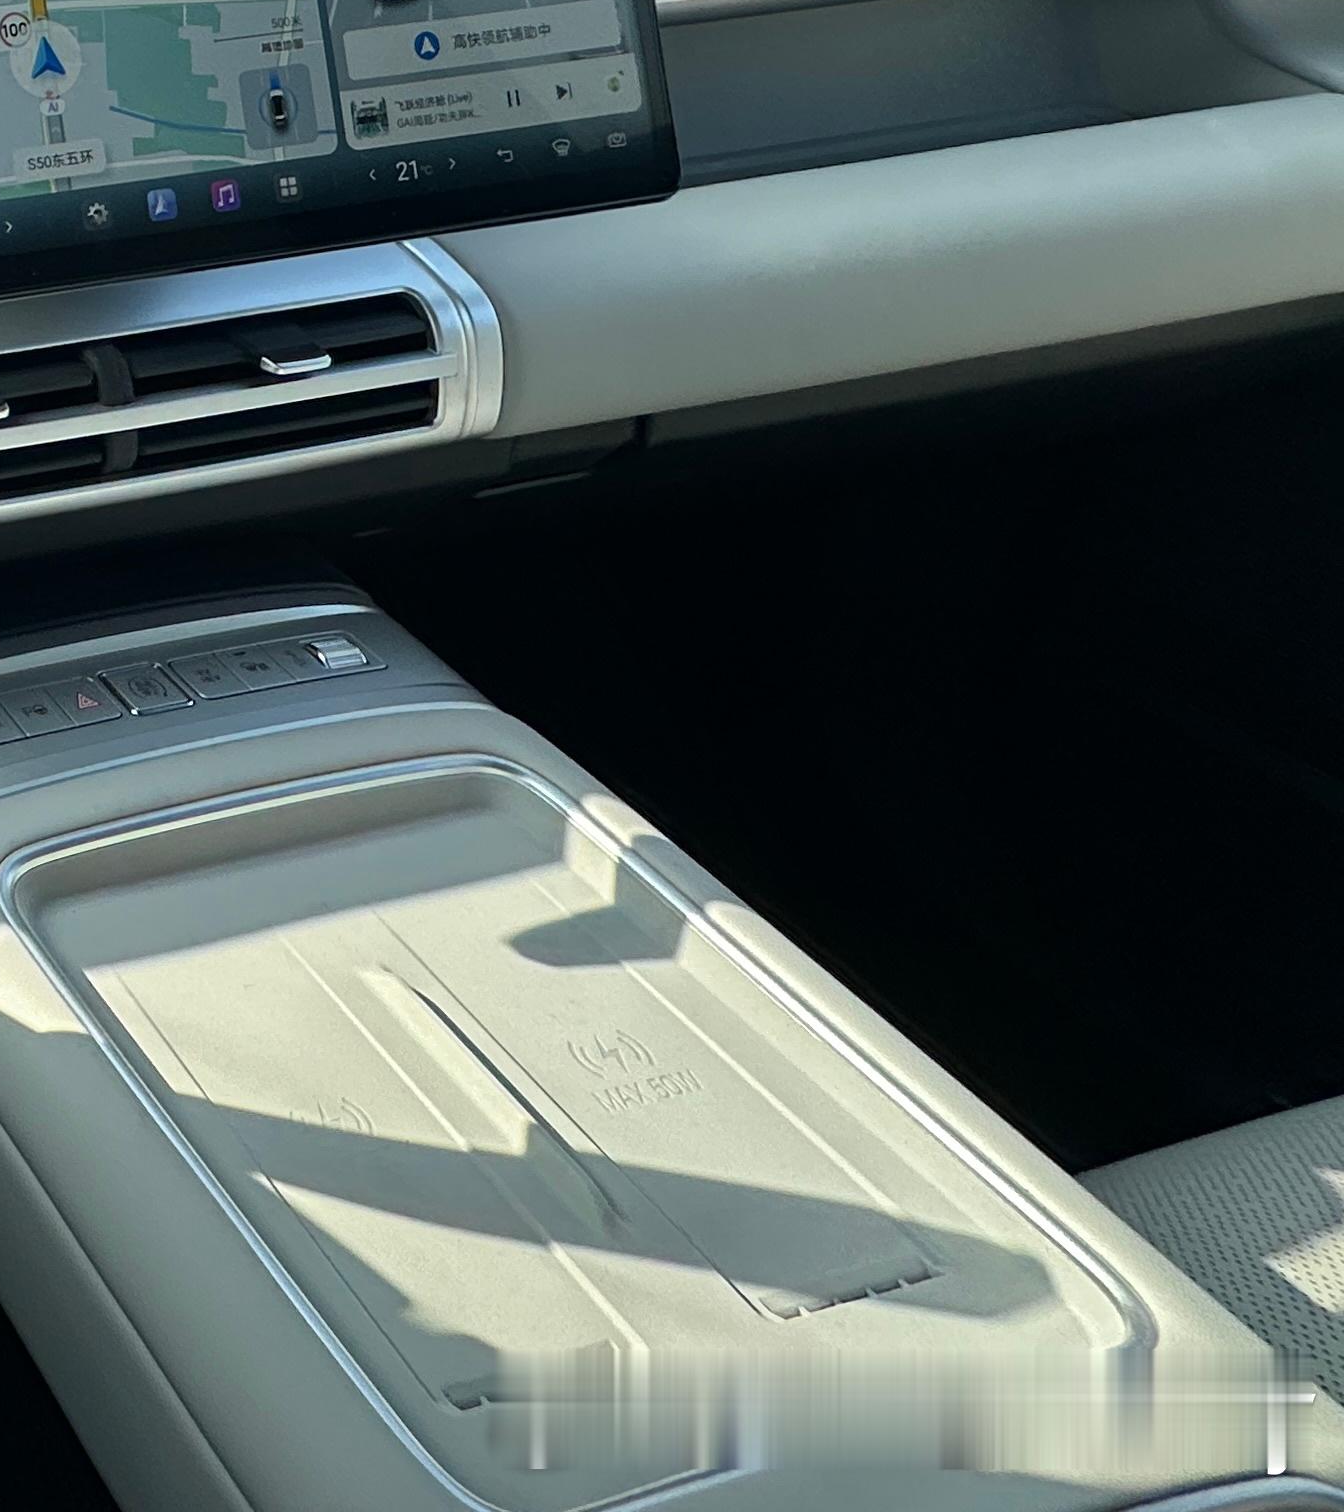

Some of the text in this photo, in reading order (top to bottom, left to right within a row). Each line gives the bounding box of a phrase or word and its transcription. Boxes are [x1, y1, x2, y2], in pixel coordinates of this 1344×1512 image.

[1, 22, 28, 39] 100
[27, 149, 94, 172] S50东五环
[591, 1067, 705, 1114] MAX 50W
